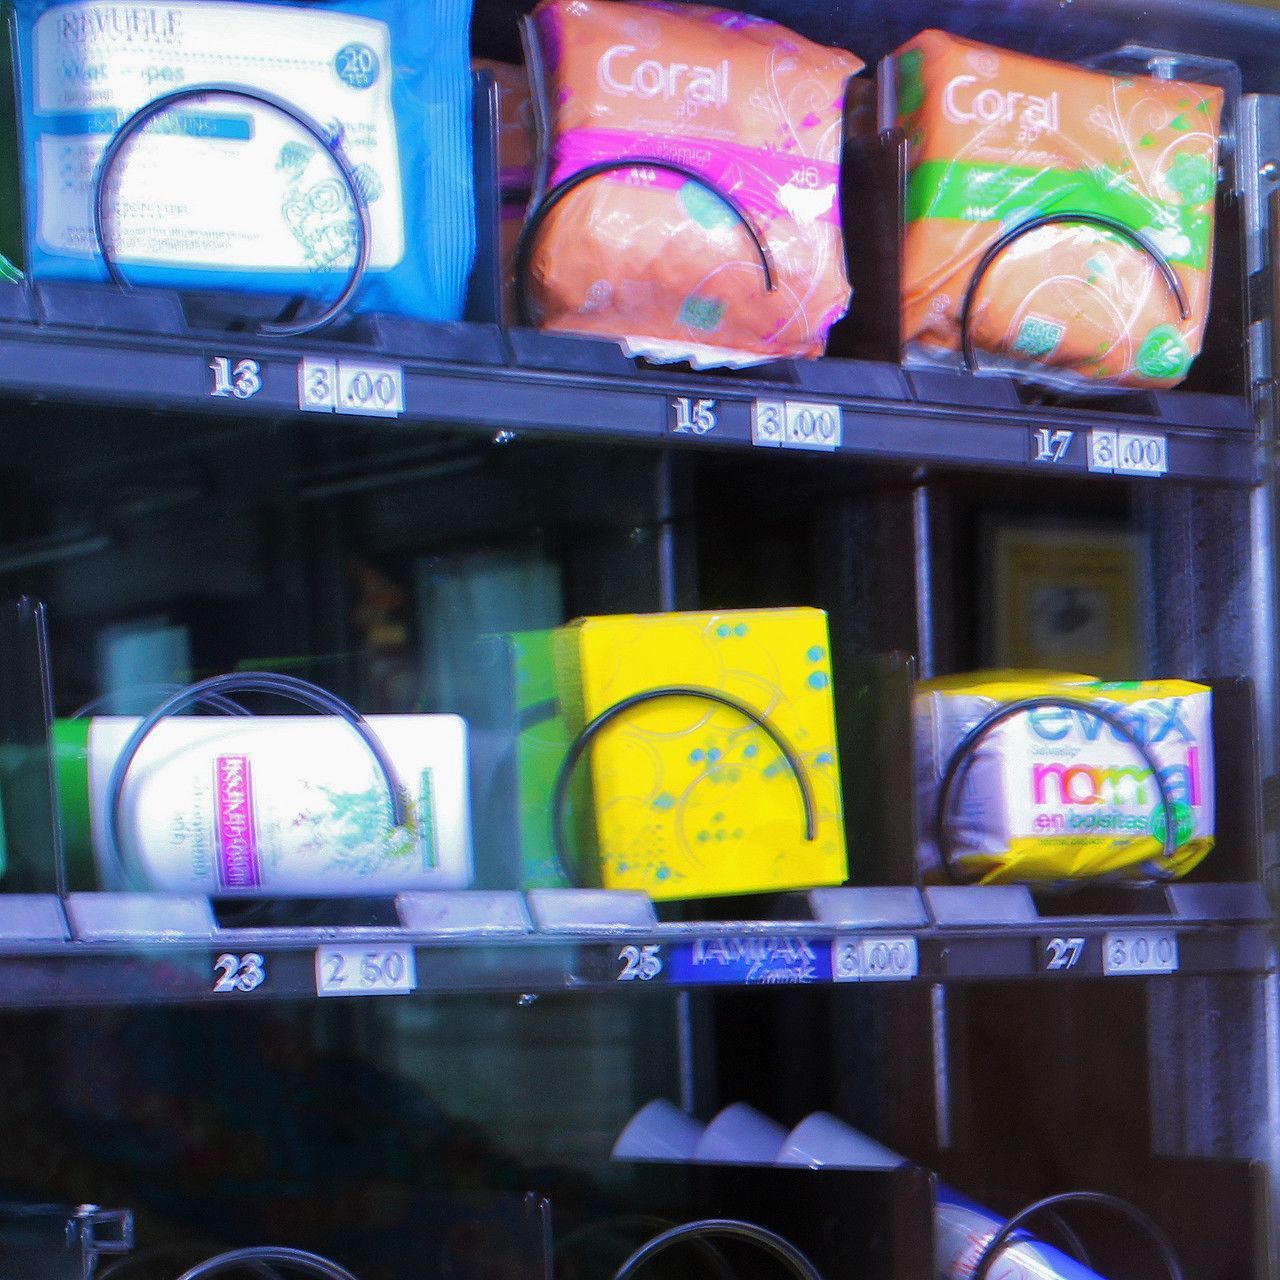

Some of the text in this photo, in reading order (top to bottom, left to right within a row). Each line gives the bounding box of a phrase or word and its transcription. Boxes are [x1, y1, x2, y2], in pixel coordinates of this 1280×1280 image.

[337, 48, 373, 75] 20
[597, 44, 730, 105] Coral
[942, 75, 1060, 133] Coral
[209, 356, 262, 399] 13
[672, 398, 718, 435] 15
[1033, 428, 1073, 461] 17
[1032, 746, 1203, 807] normal
[617, 944, 663, 981] 25
[691, 937, 817, 966] TAMPAX
[1046, 937, 1086, 970] 27
[213, 952, 266, 992] 23
